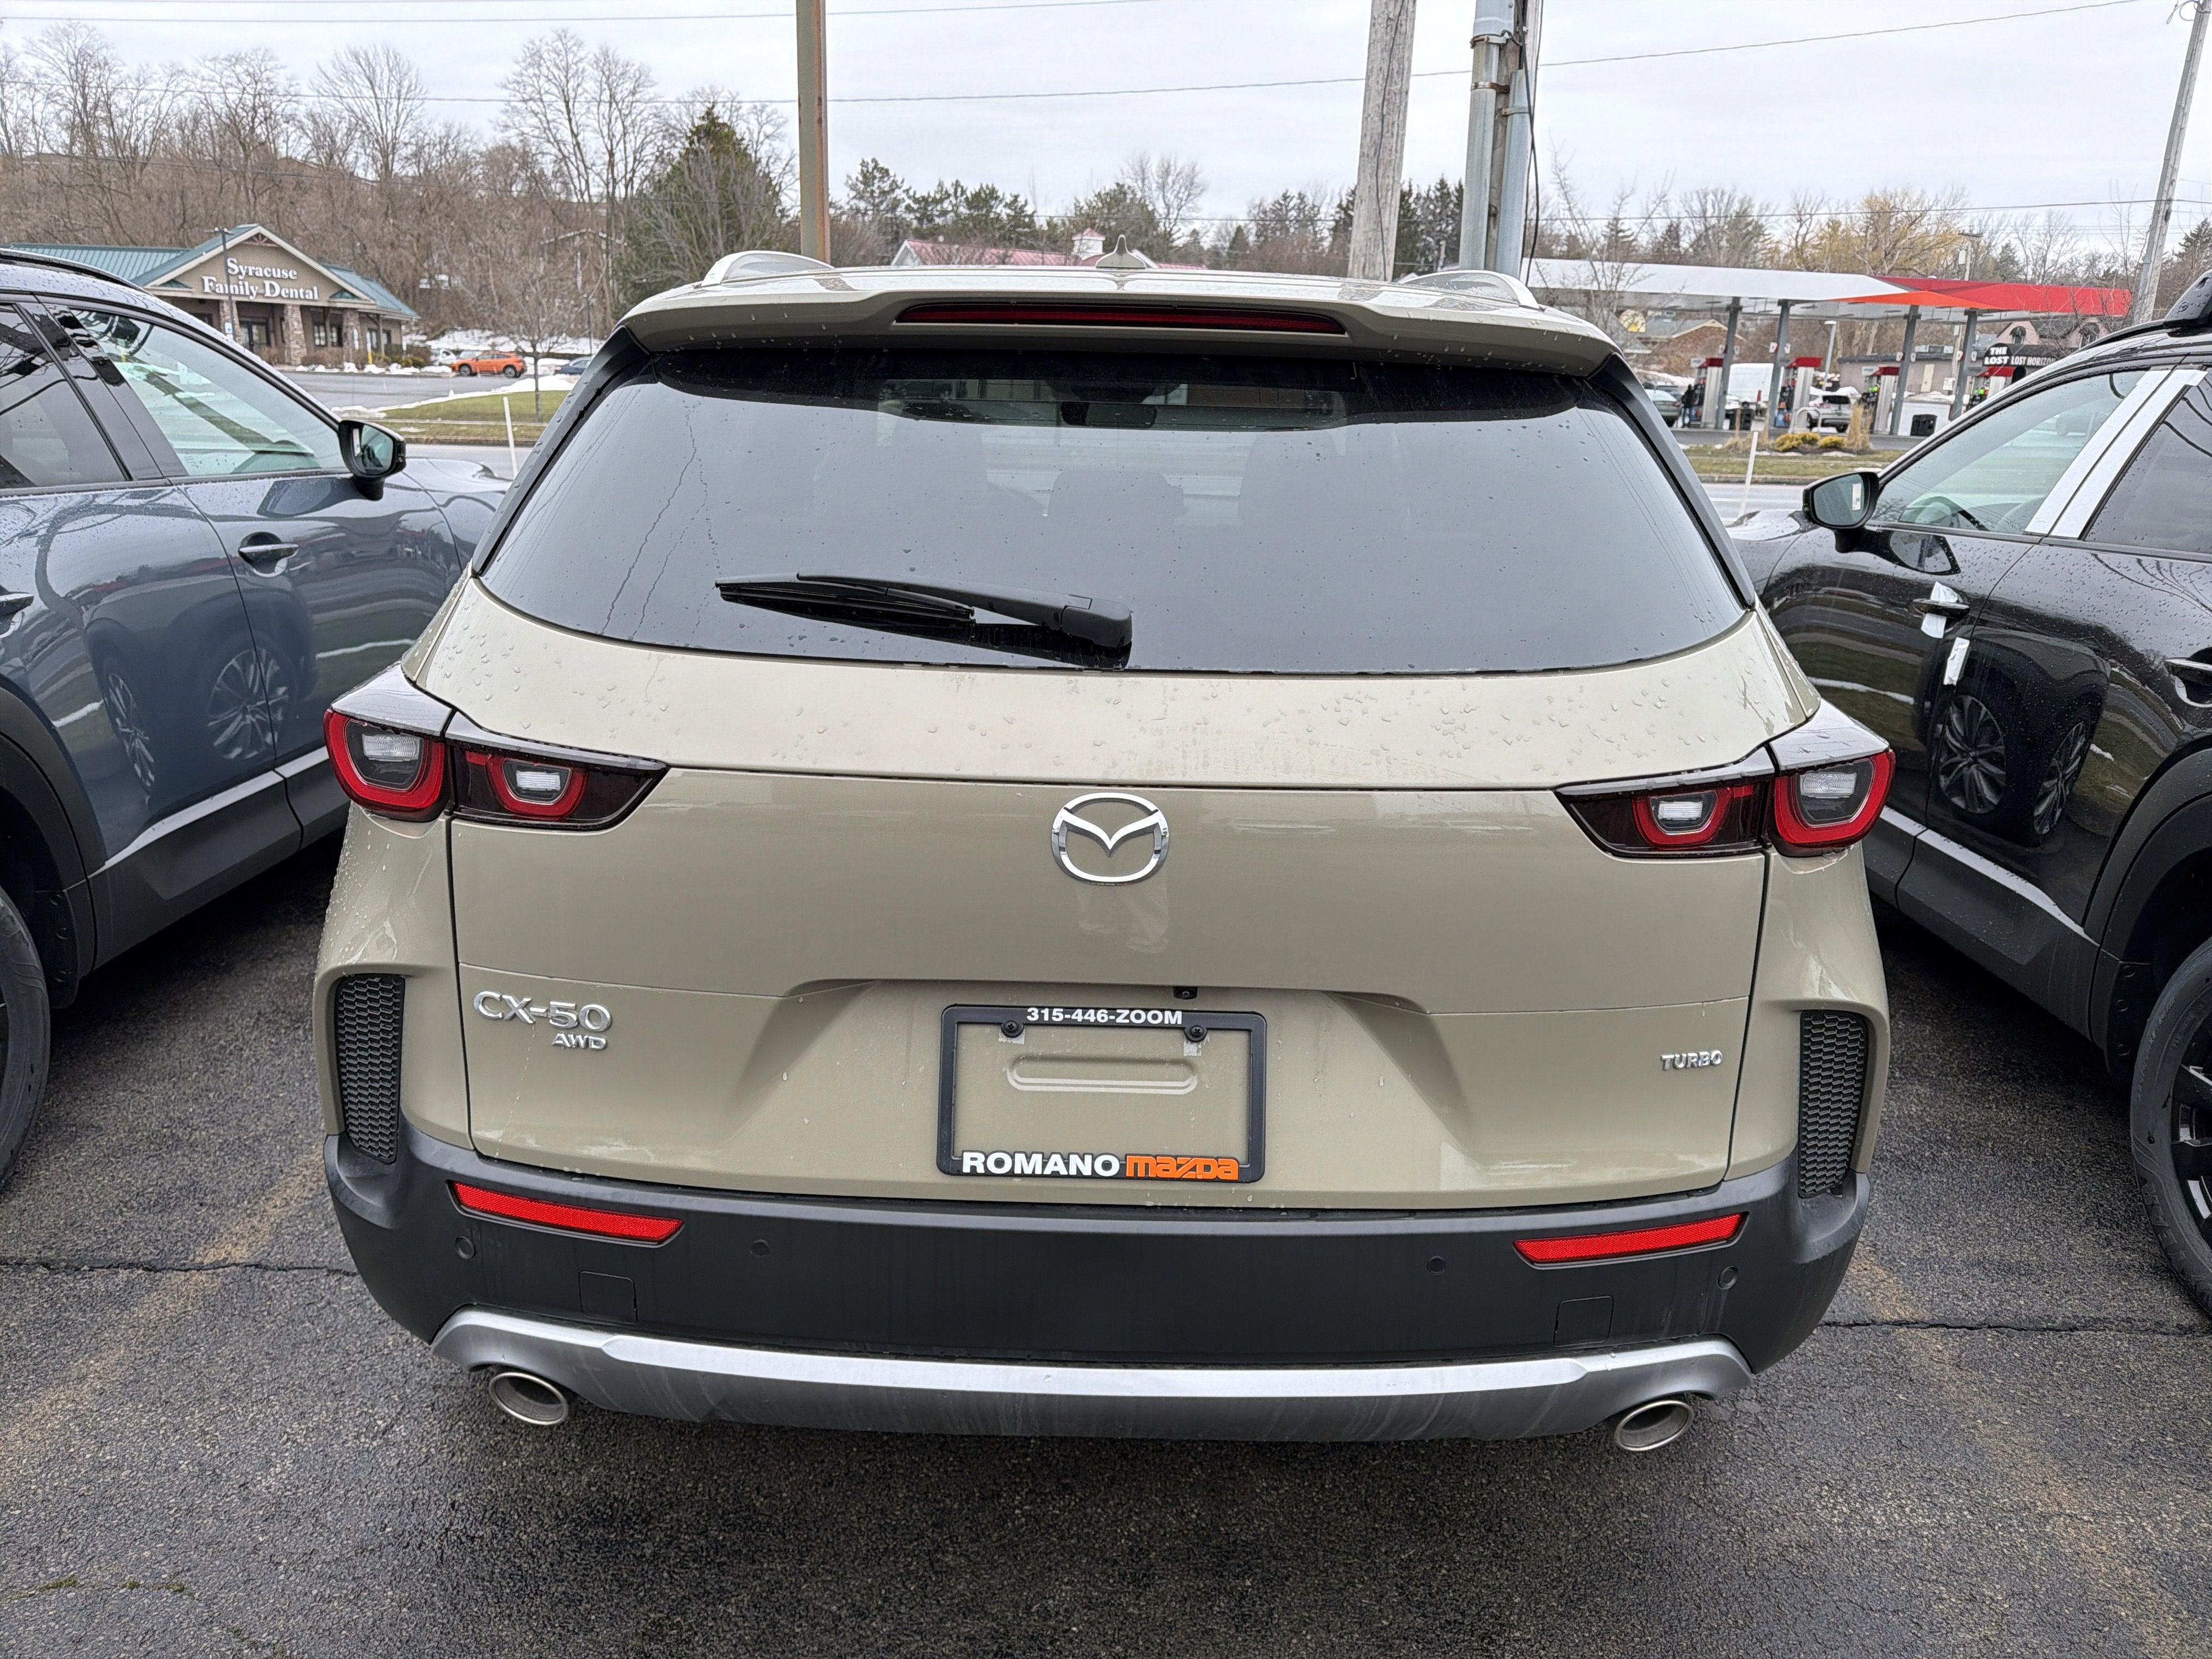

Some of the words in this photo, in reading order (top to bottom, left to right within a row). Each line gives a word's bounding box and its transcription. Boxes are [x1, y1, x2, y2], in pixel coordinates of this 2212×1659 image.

[227, 257, 297, 280] Syracuse
[202, 275, 259, 300] Family
[263, 280, 319, 300] Dental
[1984, 356, 2010, 365] LOST
[1990, 346, 2007, 356] THE
[2010, 355, 2027, 365] LOST
[473, 991, 613, 1032] CX-50
[1026, 1007, 1183, 1025] 315-446-ZOOM
[551, 1031, 607, 1050] AWD
[1661, 1050, 1723, 1070] TURBO
[962, 1151, 1120, 1177] ROMANO
